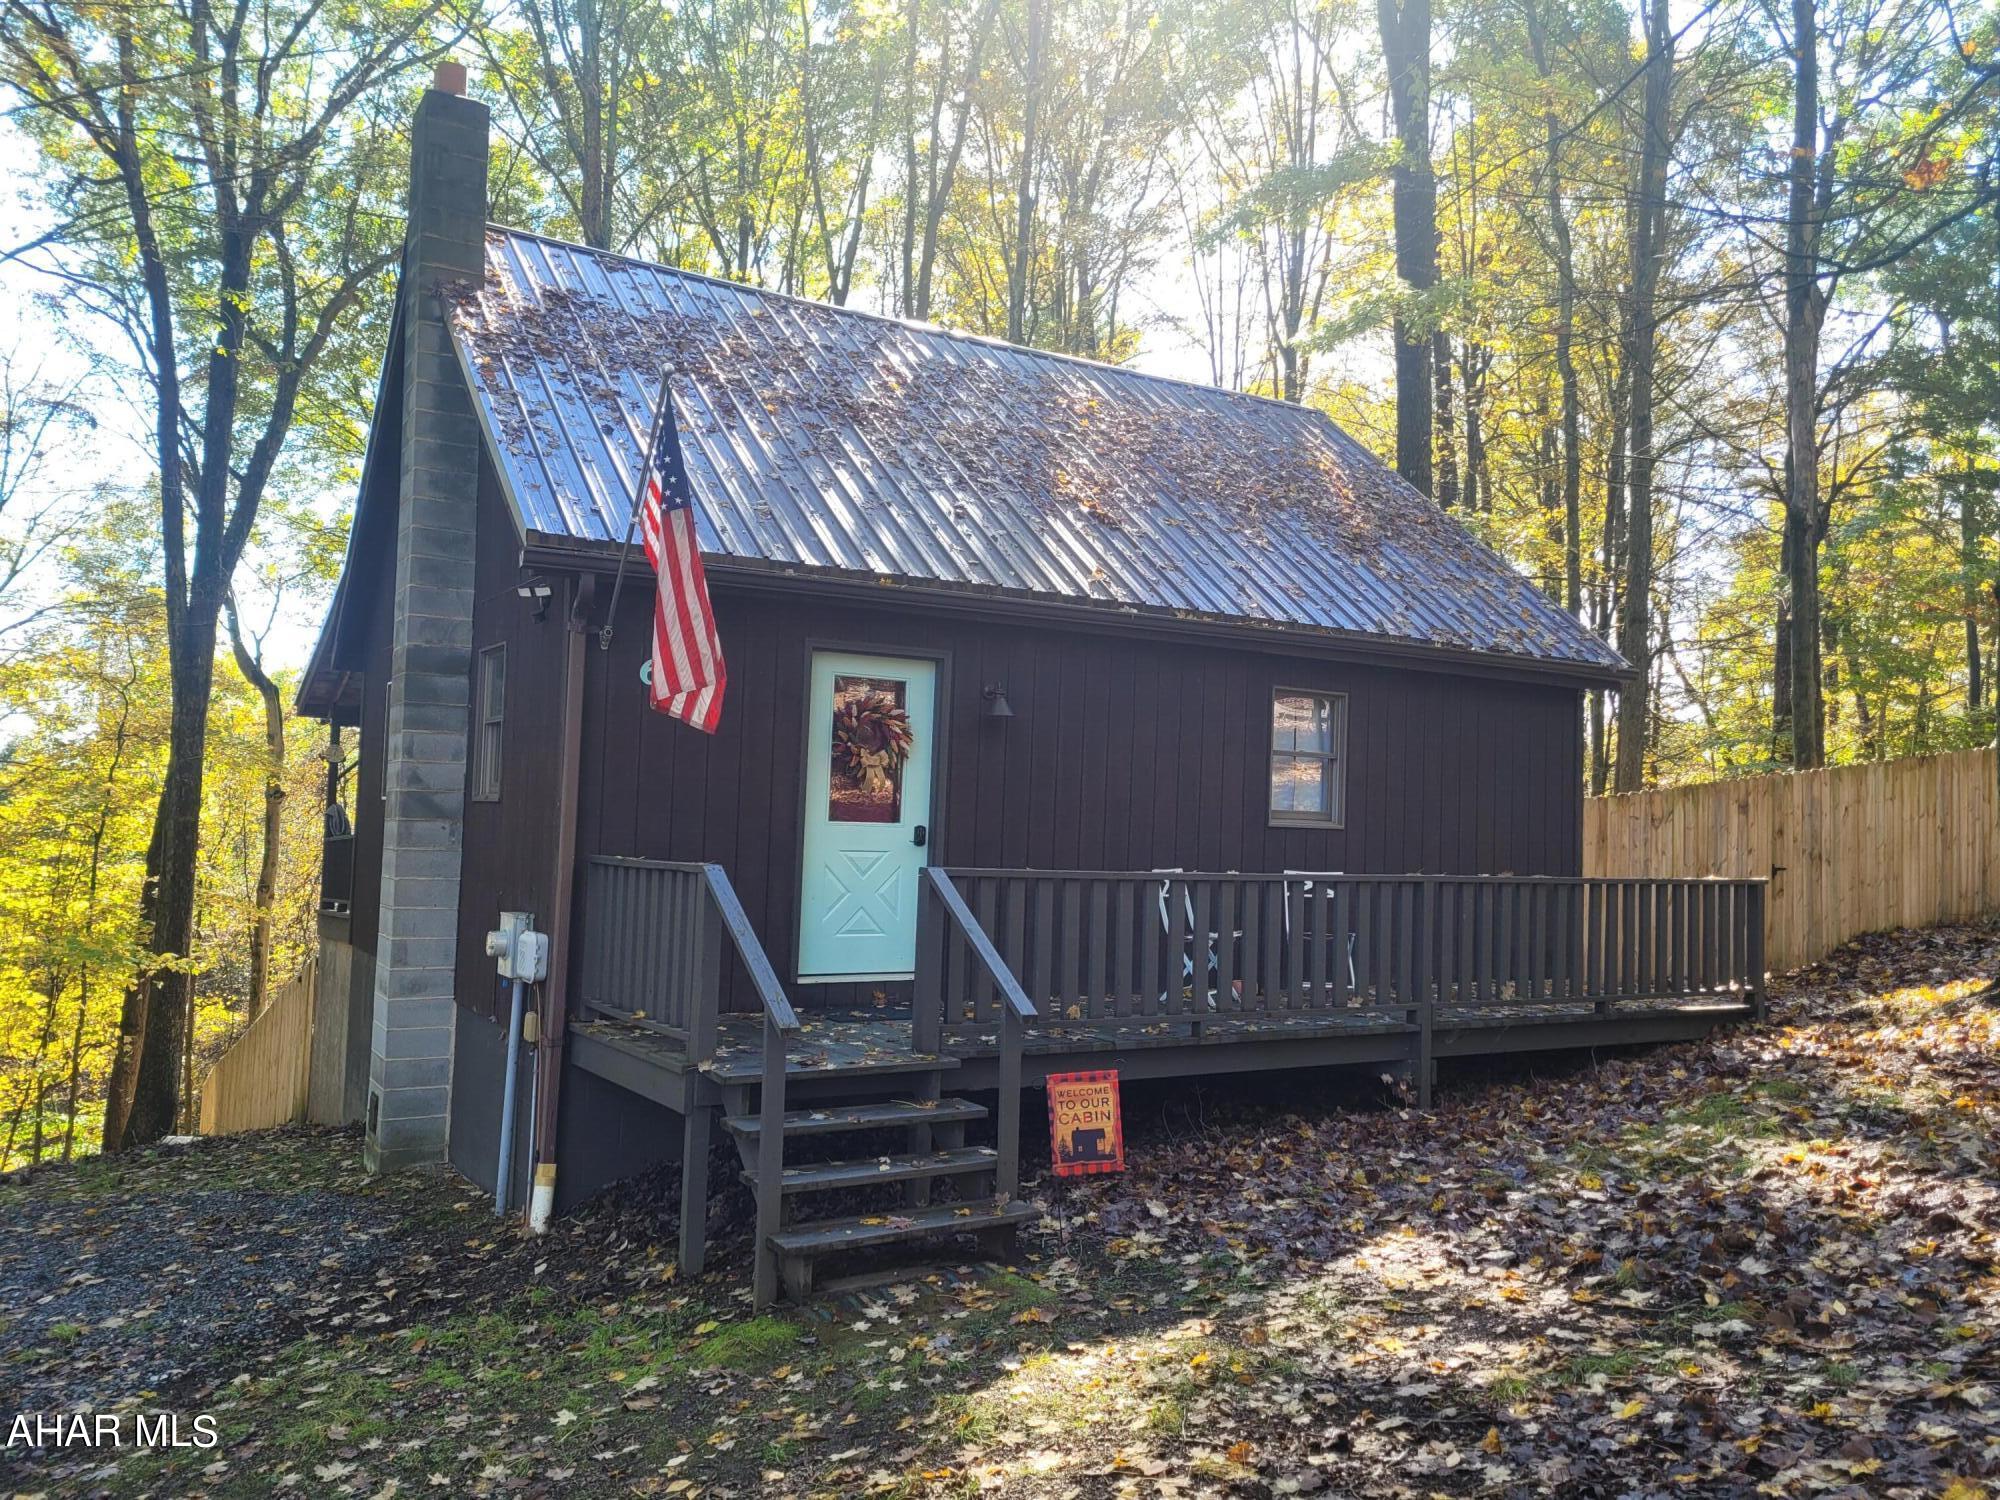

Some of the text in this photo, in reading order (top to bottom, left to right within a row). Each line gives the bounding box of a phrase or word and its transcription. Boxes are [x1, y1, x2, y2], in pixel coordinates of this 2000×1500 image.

[1056, 1086, 1109, 1098] WELCOME
[1058, 1097, 1110, 1111] TO OUR
[1058, 1110, 1111, 1125] CABIN
